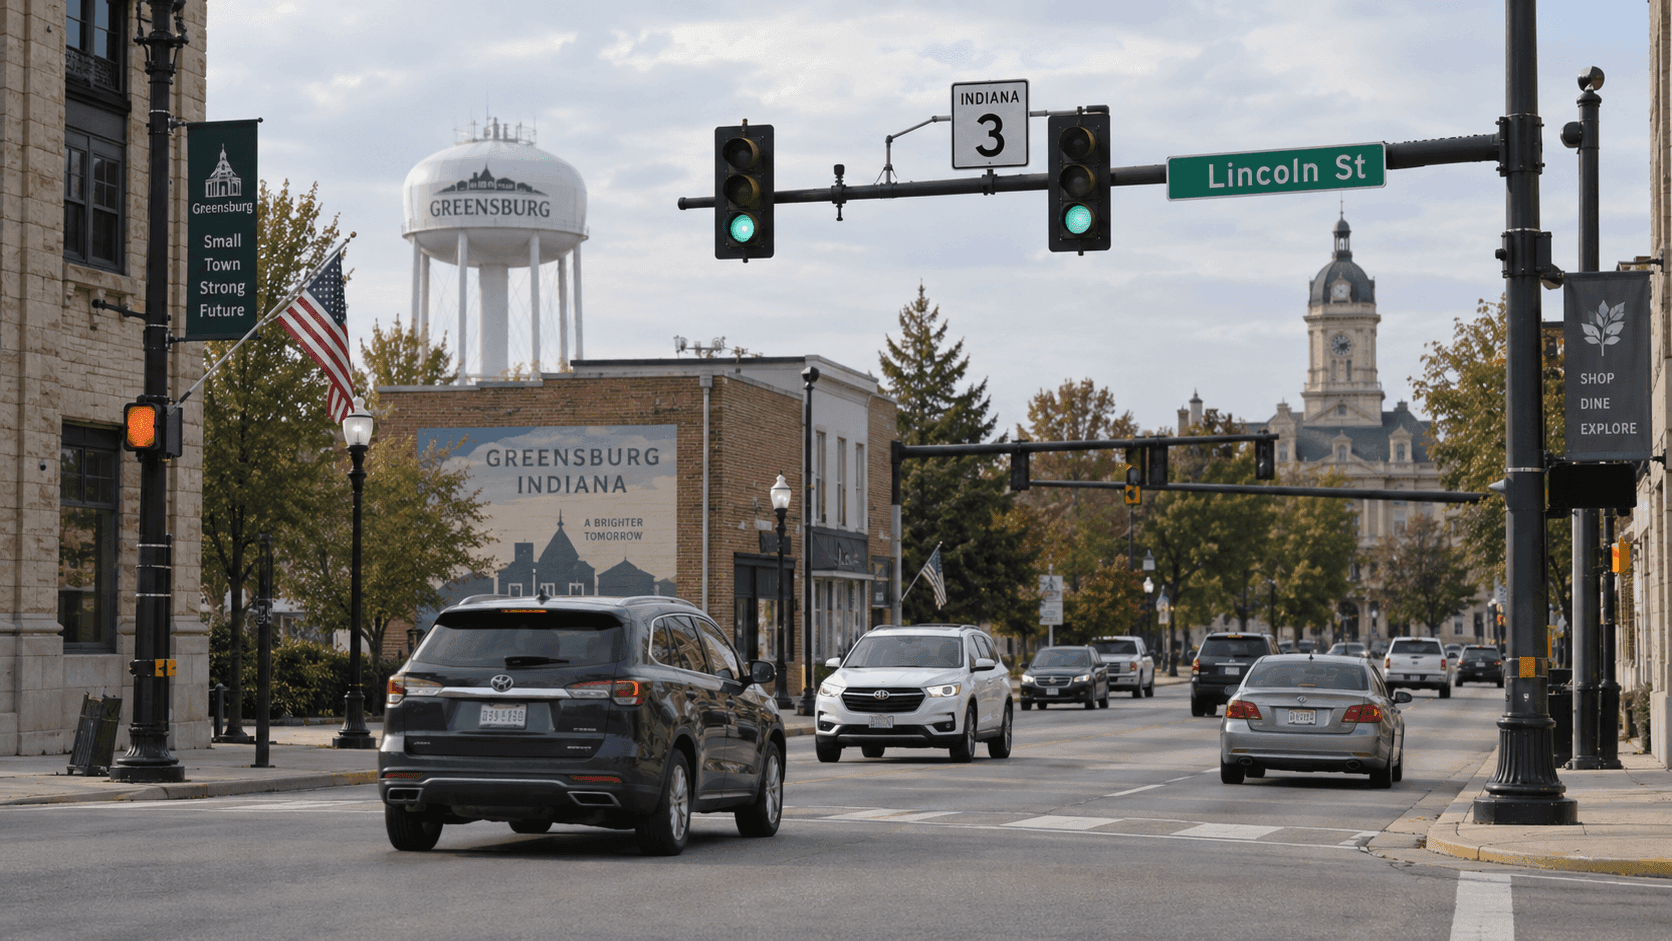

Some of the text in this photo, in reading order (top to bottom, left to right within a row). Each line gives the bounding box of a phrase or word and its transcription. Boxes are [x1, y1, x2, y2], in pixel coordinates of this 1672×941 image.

[960, 89, 1020, 106] INDIANA
[976, 114, 1005, 158] 3
[1207, 153, 1367, 189] Lincoln St
[192, 200, 253, 215] Greensburg
[430, 197, 550, 218] GREENSBURG
[204, 233, 241, 249] Small
[204, 257, 241, 272] Town
[199, 280, 245, 297] Strong
[199, 303, 245, 318] Future
[1580, 372, 1615, 385] SHOP
[1580, 397, 1611, 410] DINE
[1580, 422, 1638, 435] EXPLORE
[486, 447, 660, 467] GREENSBURG
[518, 474, 628, 494] INDIANA
[584, 517, 644, 528] A BRIGHTER
[584, 530, 643, 541] TOMORROW
